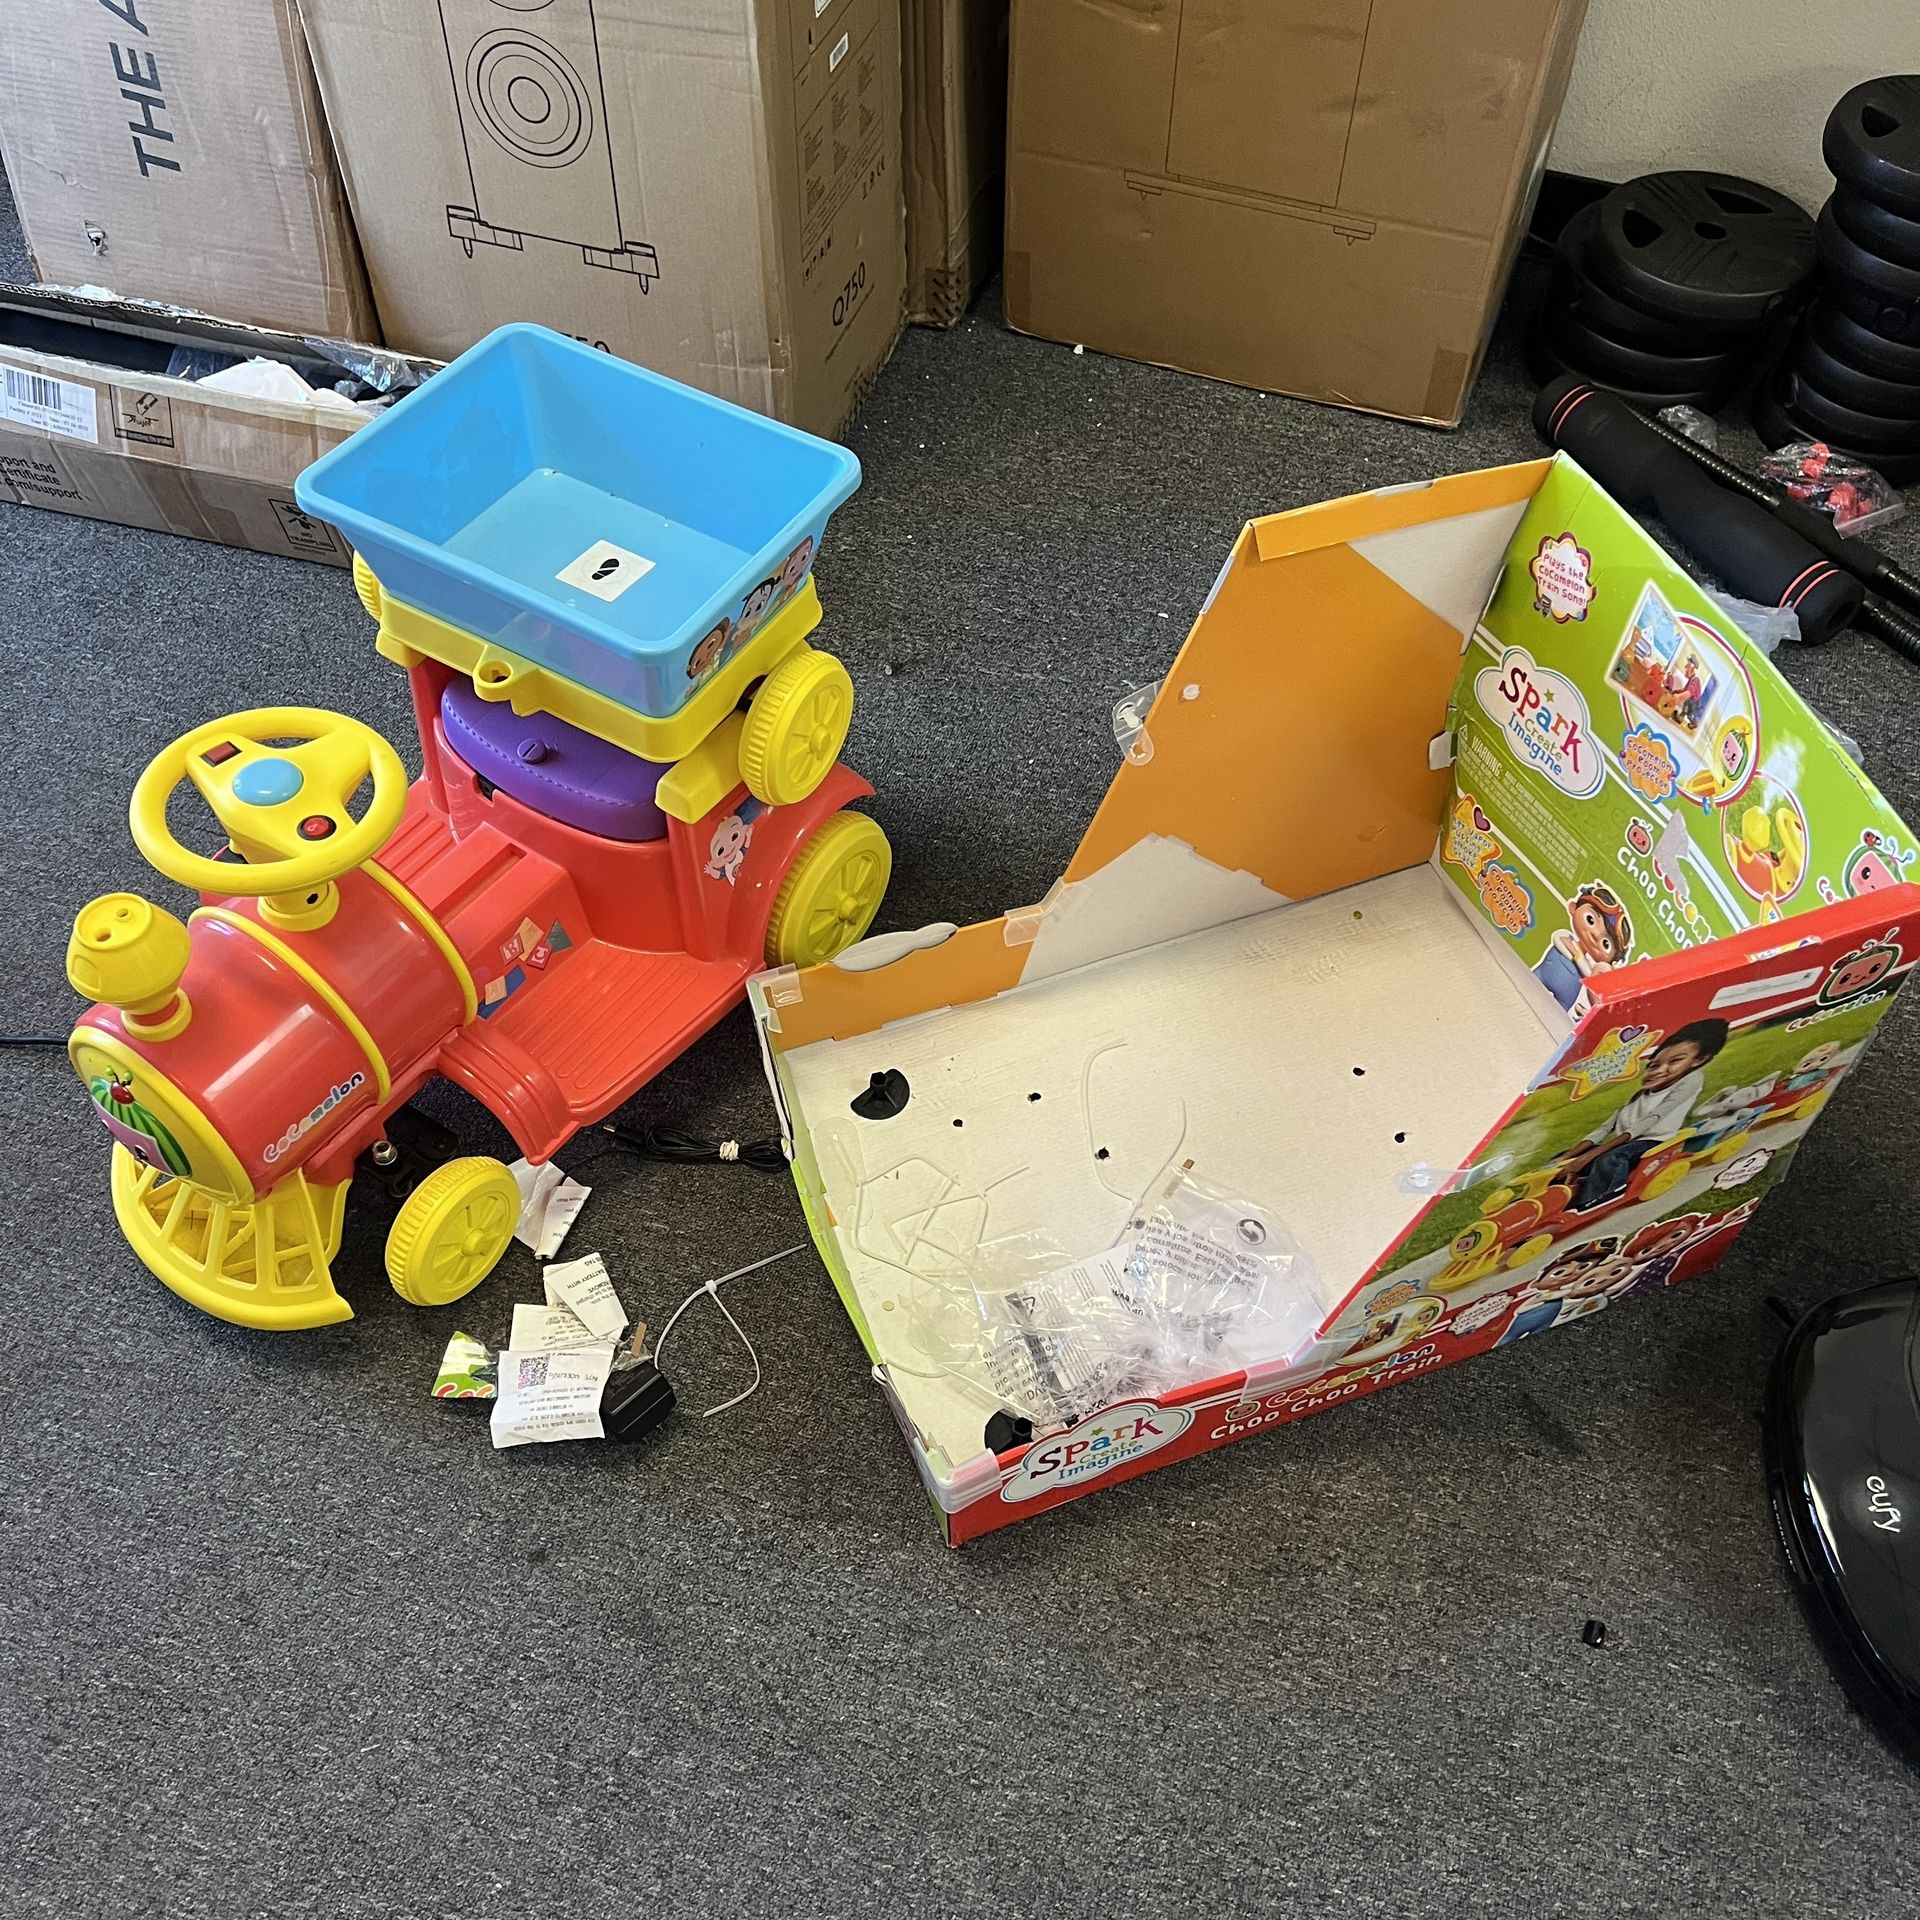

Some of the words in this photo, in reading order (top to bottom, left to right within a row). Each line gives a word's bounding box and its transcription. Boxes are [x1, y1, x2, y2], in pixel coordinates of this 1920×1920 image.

[108, 42, 182, 178] THE
[832, 260, 866, 328] Q750
[32, 461, 57, 474] and
[1537, 576, 1560, 594] Train
[1543, 553, 1566, 572] Plays
[1568, 567, 1584, 581] the
[1498, 667, 1583, 774] Spark
[1508, 711, 1562, 776] Imagine
[1524, 718, 1564, 762] Create
[1616, 846, 1658, 900] Choo
[1210, 1409, 1280, 1440] Choo
[1290, 1382, 1358, 1413] Choo
[1371, 1353, 1443, 1386] Train
[1030, 1416, 1164, 1481] Spark
[1057, 1442, 1144, 1481] Imagine
[1079, 1440, 1138, 1465] Create
[1866, 1475, 1902, 1534] eufy
